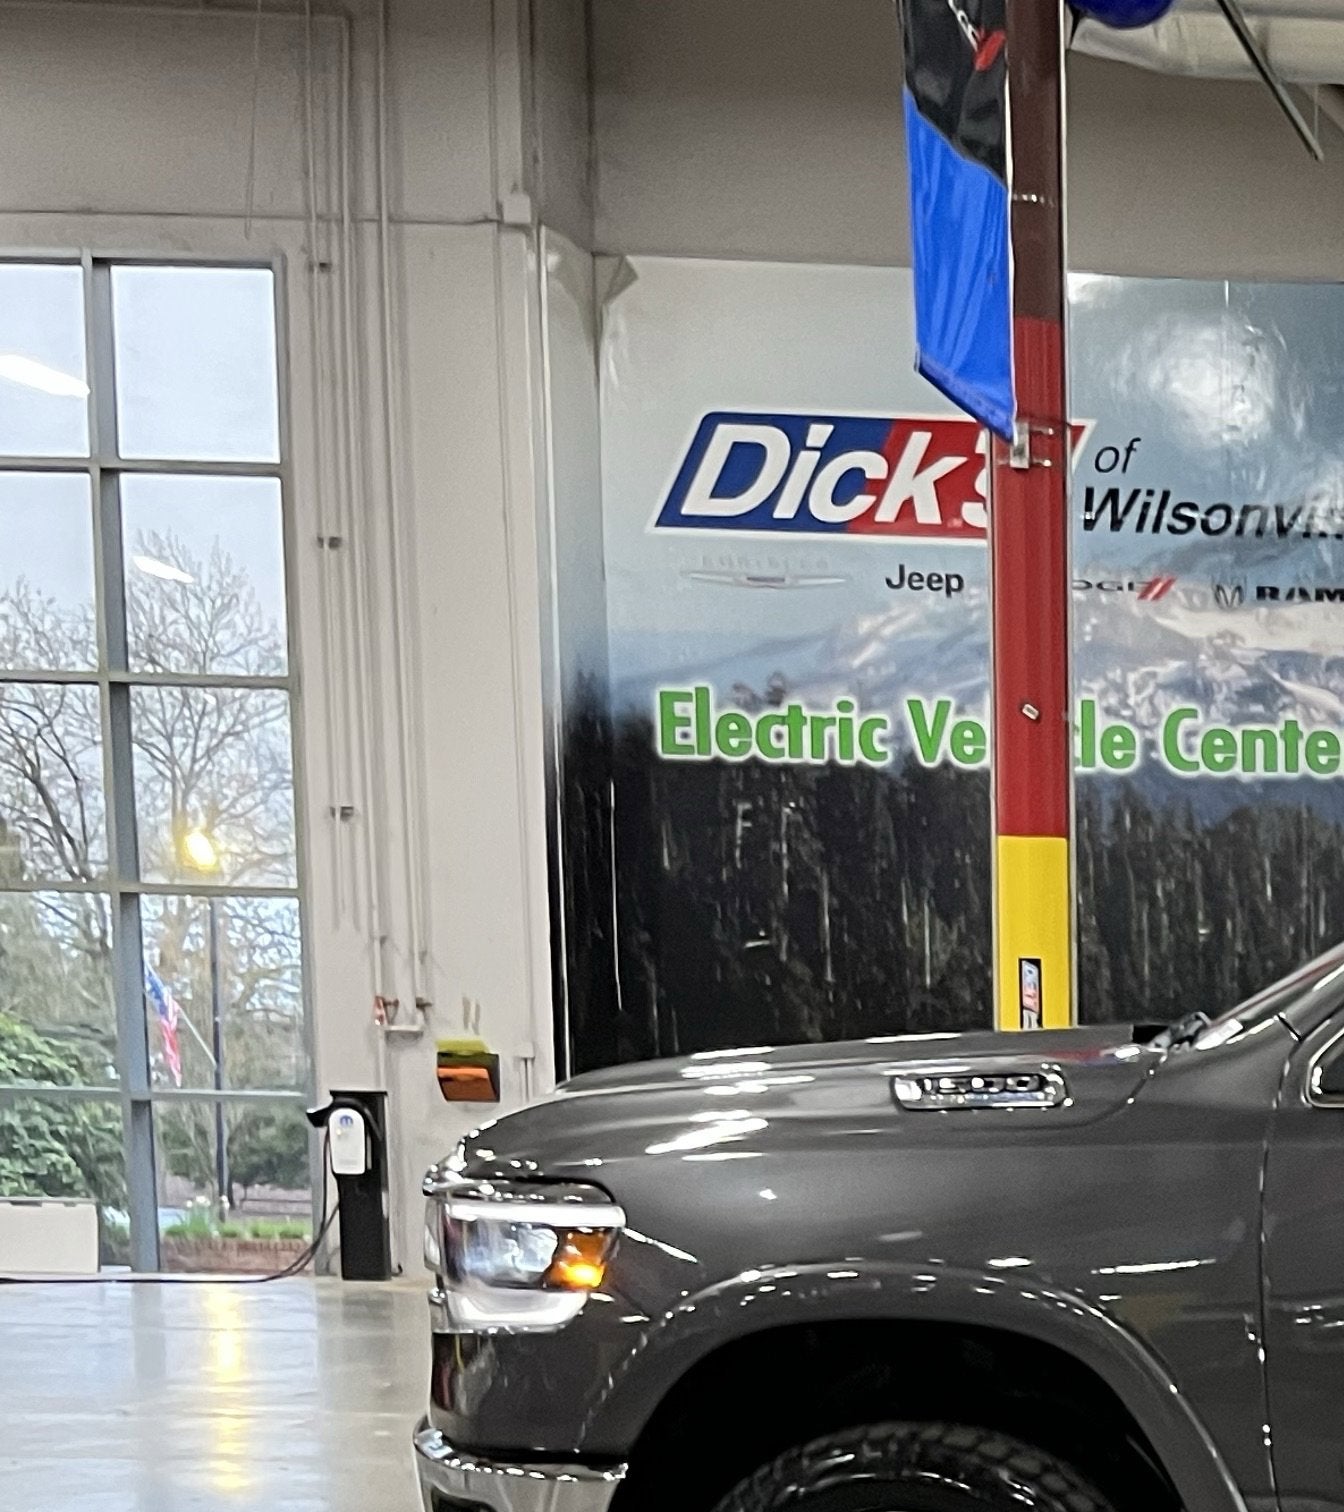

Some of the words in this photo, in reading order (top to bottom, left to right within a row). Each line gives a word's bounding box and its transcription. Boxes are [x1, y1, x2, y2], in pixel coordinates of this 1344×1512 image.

[680, 423, 988, 529] Dick
[1093, 436, 1142, 474] of
[885, 563, 965, 598] Jeep
[657, 685, 890, 764] Electric
[906, 697, 1138, 771] Vele
